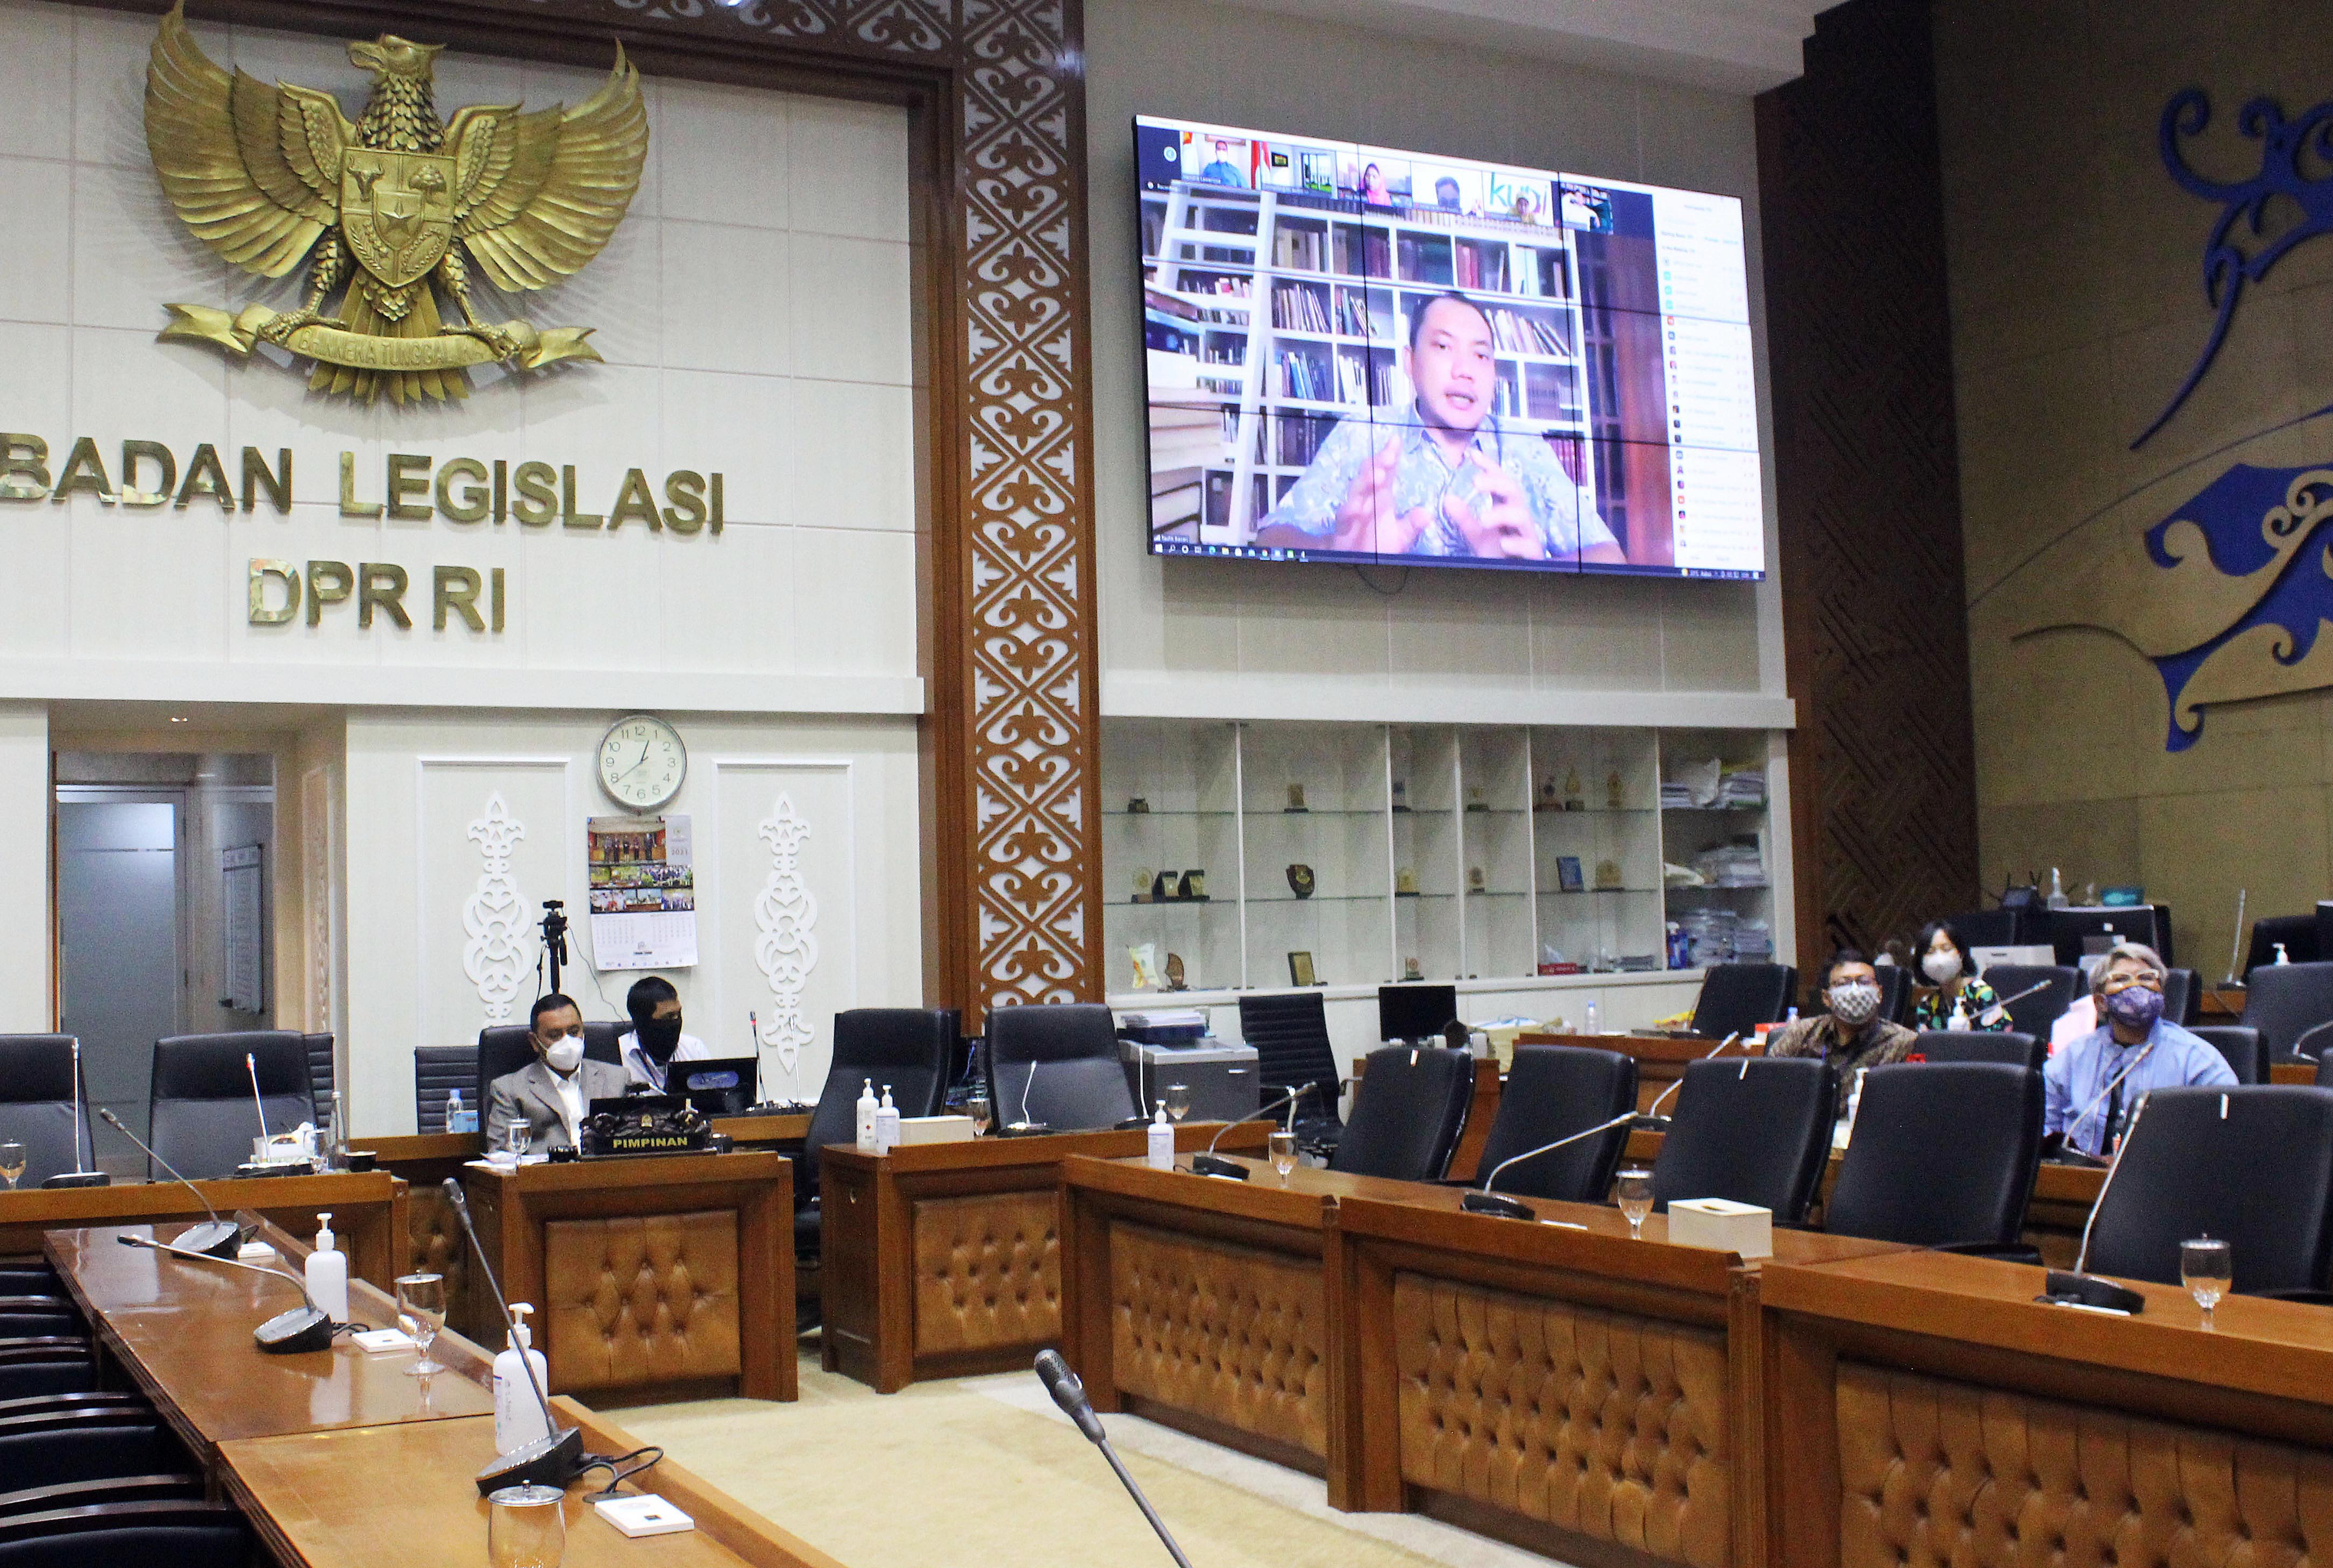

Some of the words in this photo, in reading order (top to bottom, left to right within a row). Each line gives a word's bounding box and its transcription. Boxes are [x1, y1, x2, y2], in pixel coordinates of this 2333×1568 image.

[0, 433, 292, 515] BADAN
[339, 451, 724, 536] LEGISLASI
[248, 557, 412, 630] DPR
[433, 565, 506, 632] RI
[622, 729, 629, 739] 11
[635, 726, 645, 736] 12
[655, 729, 658, 739] 1
[609, 742, 621, 752] 10
[663, 742, 671, 752] 2
[606, 757, 615, 767] 9
[667, 758, 675, 767] 3
[610, 773, 619, 783] 8
[663, 773, 670, 782] 4
[623, 785, 631, 795] 7
[637, 789, 646, 800] 6
[652, 785, 660, 795] 5
[613, 1137, 688, 1149] PIMPINAN
